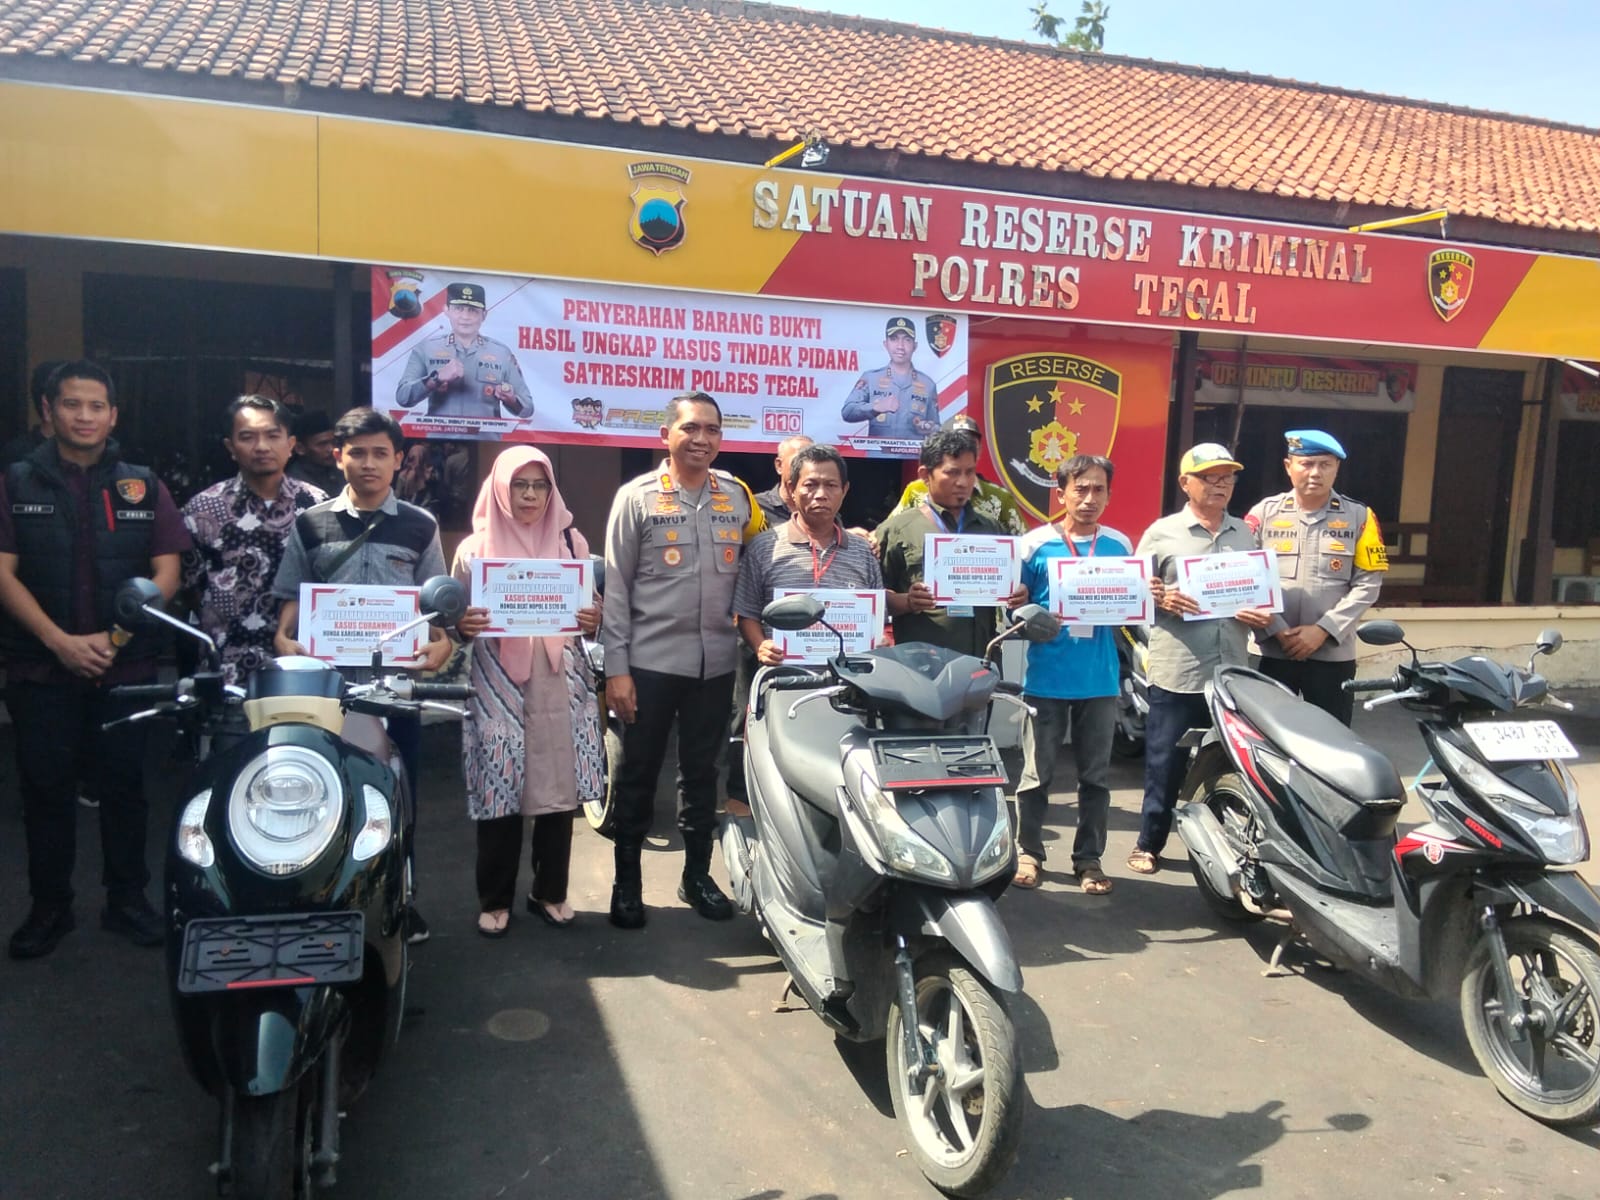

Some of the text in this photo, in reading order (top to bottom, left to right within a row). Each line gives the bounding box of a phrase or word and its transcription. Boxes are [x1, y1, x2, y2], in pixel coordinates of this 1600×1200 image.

[633, 163, 689, 180] JAWA TENGAH
[752, 179, 1373, 285] SATUAN RESERSE KRIMINAL
[910, 252, 1258, 325] POLRES TEGAL
[562, 298, 822, 340] PENYERAHAN BARANG BUKTI
[518, 326, 860, 373] HASIL UNGKAP KASUS TINDAK PIDANA
[563, 360, 820, 399] SATRESKRIM POLRES TEGAL
[1009, 358, 1106, 385] RESERSE
[1301, 369, 1378, 394] RESKRIM
[605, 408, 665, 423] PRES
[765, 414, 801, 431] 110
[652, 516, 687, 526] BAYU P
[1322, 530, 1354, 539] POLRI
[1206, 581, 1224, 589] KASUS
[504, 594, 563, 602] KASUS CURANMOR
[334, 621, 397, 630] KASUS CURANMOR
